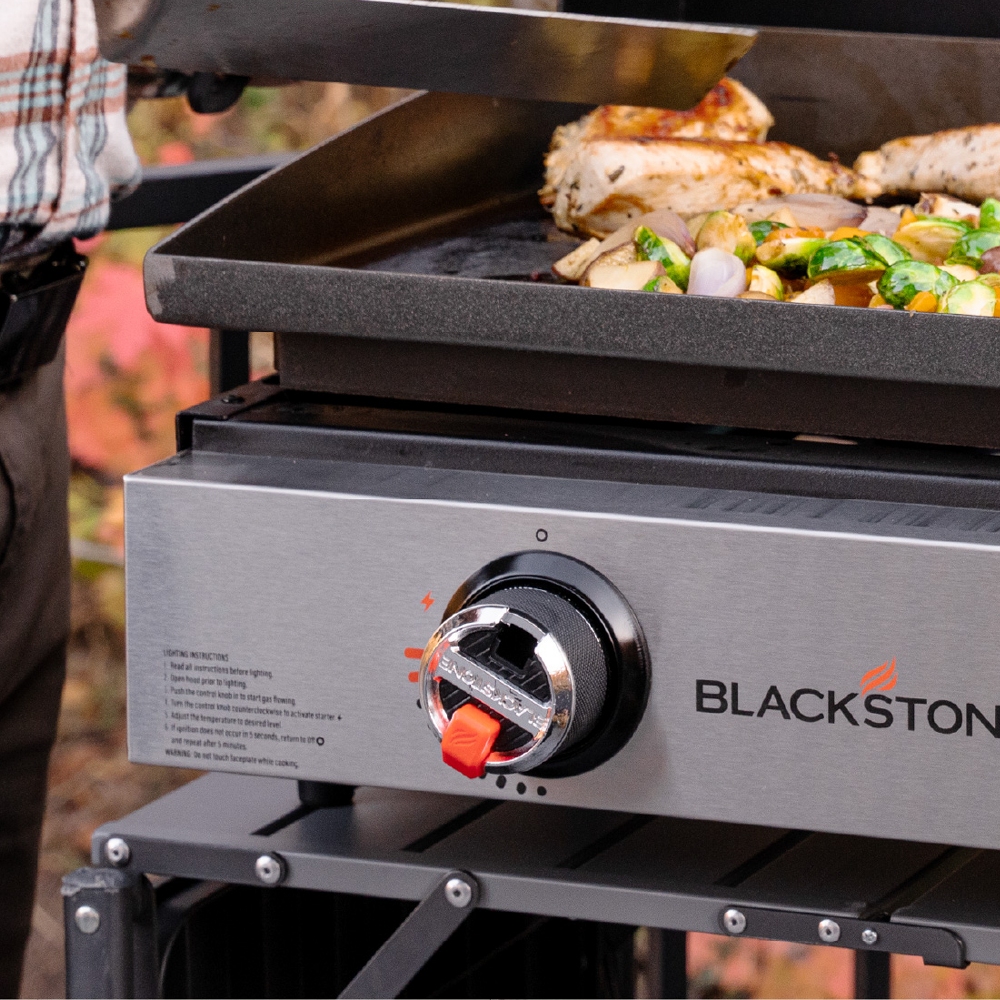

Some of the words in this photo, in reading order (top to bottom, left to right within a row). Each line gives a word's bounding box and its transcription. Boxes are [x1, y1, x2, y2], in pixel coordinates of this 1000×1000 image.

[189, 651, 229, 662] INSTRUCTIONS
[170, 661, 185, 671] Read
[194, 665, 229, 675] instructions
[229, 666, 249, 676] before
[170, 673, 185, 683] Open
[170, 685, 186, 695] Push
[185, 688, 196, 696] the
[195, 689, 217, 698] control
[246, 694, 261, 702] start
[261, 695, 272, 705] gas
[244, 718, 267, 728] desired
